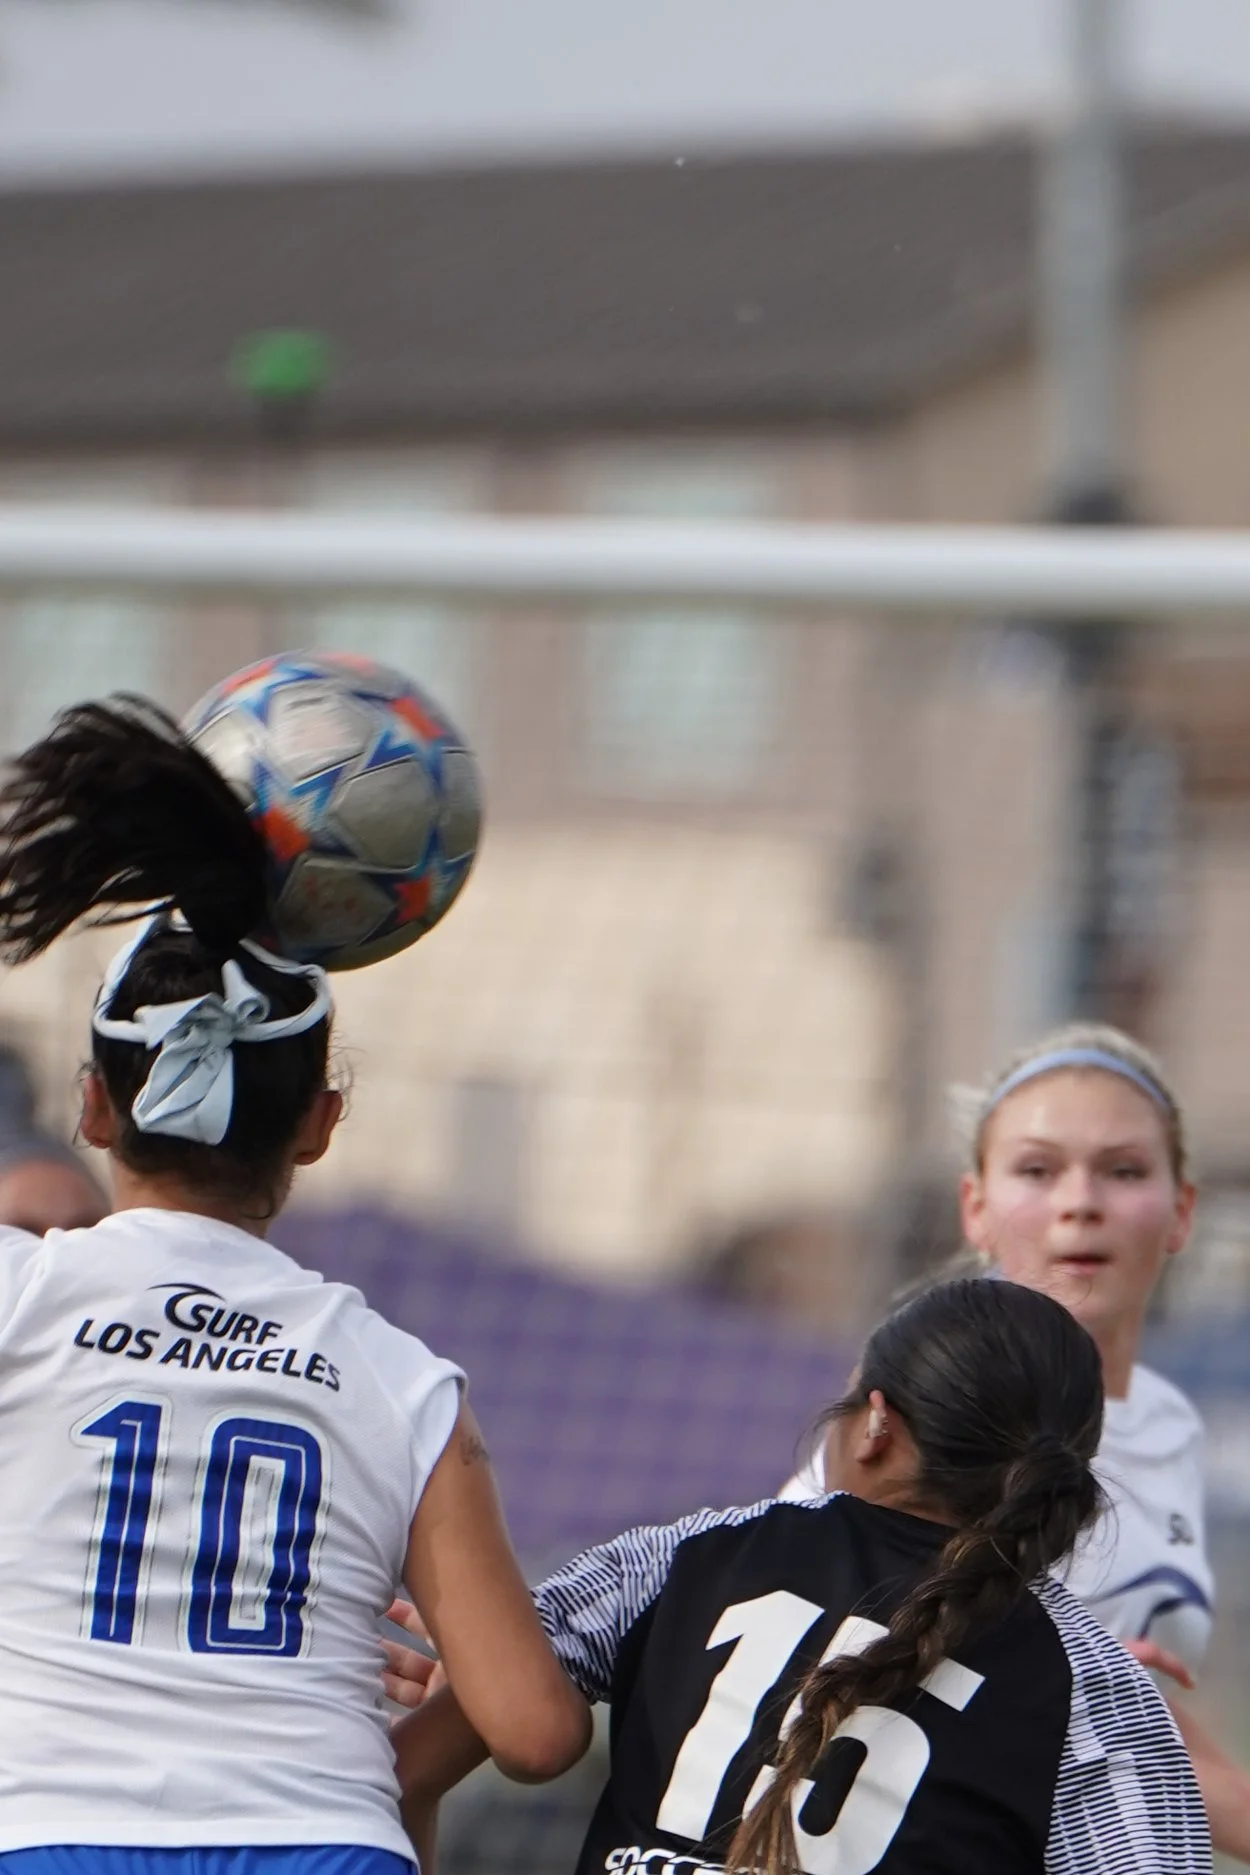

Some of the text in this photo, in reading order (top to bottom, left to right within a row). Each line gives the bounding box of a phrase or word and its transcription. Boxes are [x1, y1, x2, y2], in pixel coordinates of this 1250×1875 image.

[74, 1319, 341, 1392] LOS ANGELES
[165, 1292, 283, 1346] SURF
[79, 1399, 325, 1658] 10
